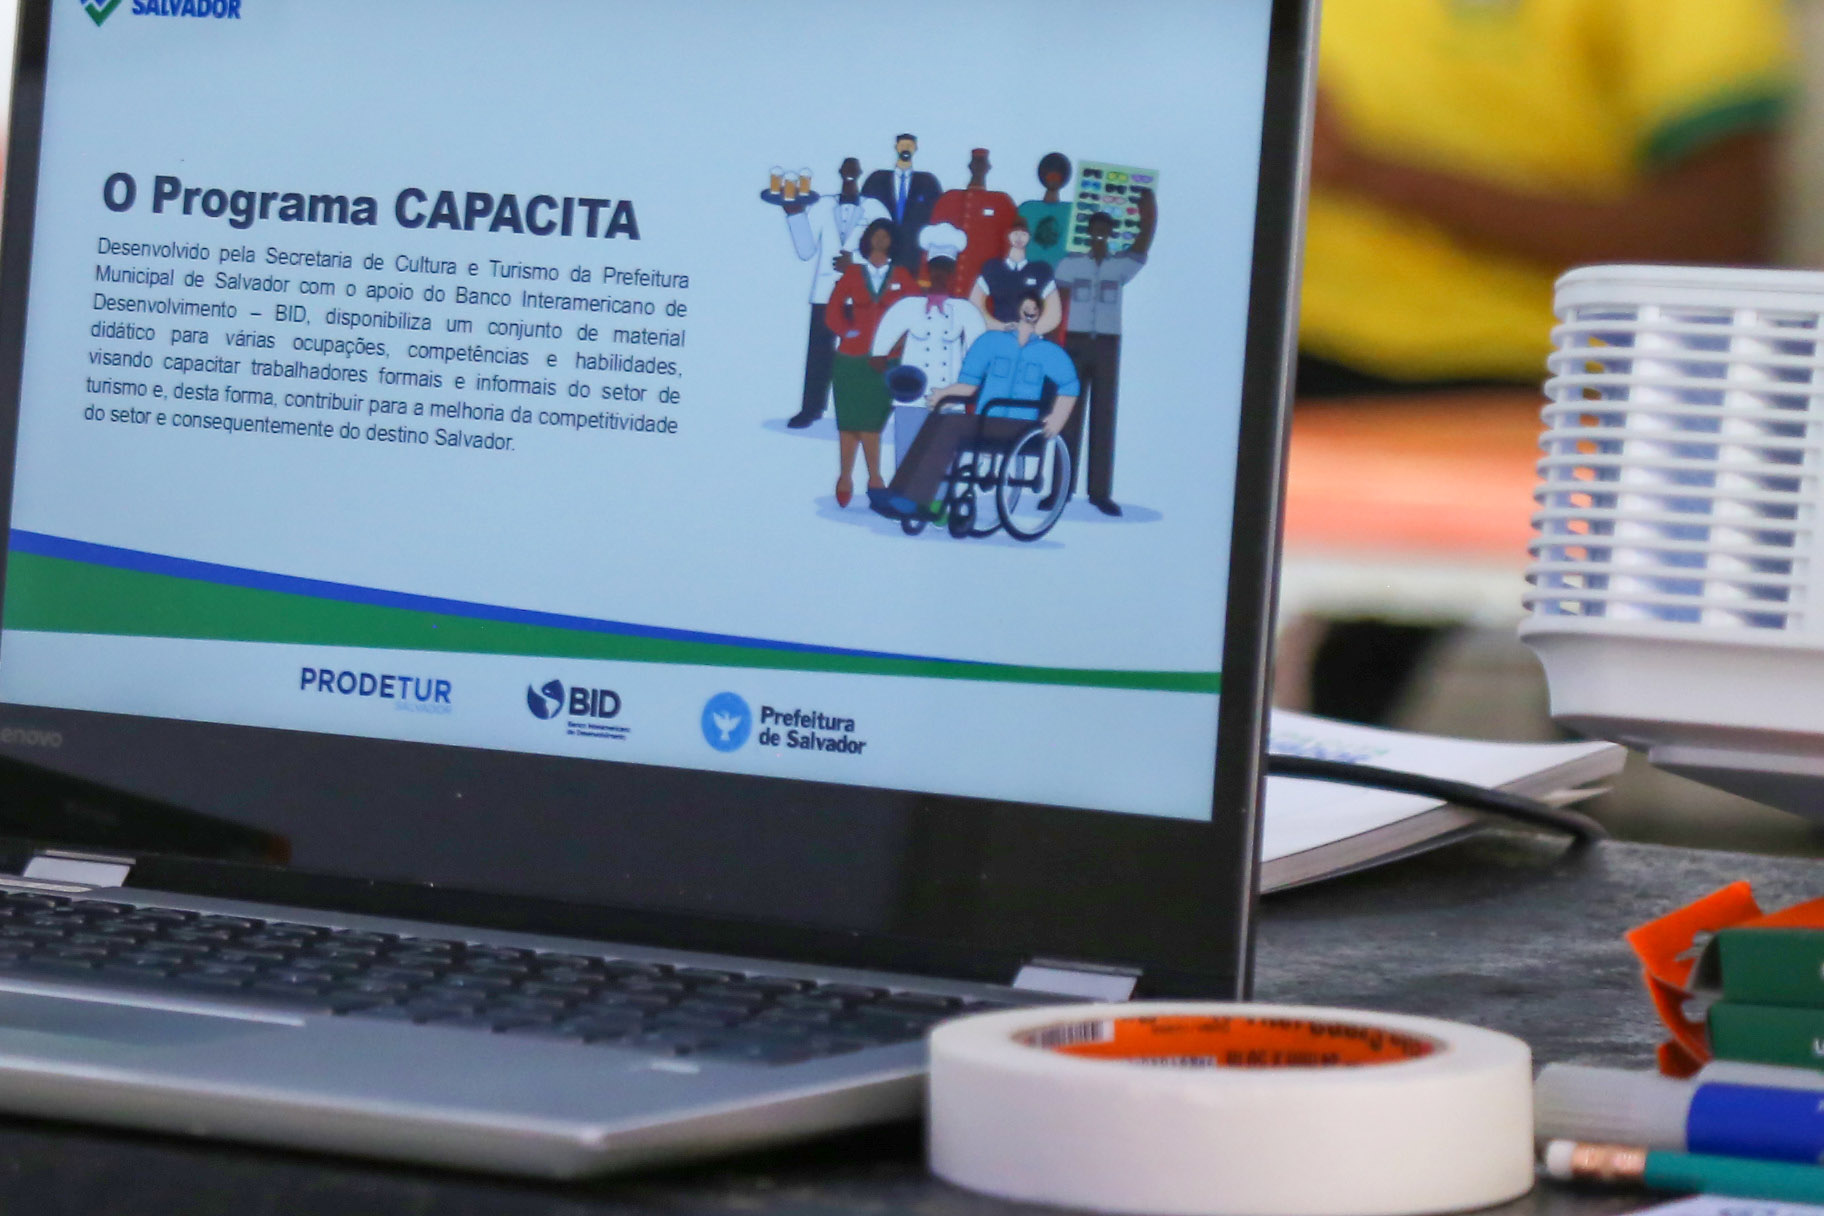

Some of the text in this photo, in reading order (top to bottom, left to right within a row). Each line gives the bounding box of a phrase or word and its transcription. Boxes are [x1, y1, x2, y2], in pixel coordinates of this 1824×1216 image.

[103, 172, 640, 240] O Programa CAPACITA
[97, 237, 690, 289] Desenvolvido pela Secretaria de Cultura e Turismo da Prefeitura
[95, 264, 688, 318] Municipal de Salvador com o apoio do Banco Interamericano de
[92, 292, 238, 319] Desenvolvimento
[274, 303, 311, 326] BID,
[325, 308, 432, 331] disponibiliza
[446, 319, 473, 334] um
[487, 320, 563, 341] conjunto
[576, 323, 599, 342] de
[613, 328, 686, 348] material
[90, 320, 682, 379] didático para várias ocupações, competências e habilidades,
[89, 348, 681, 405] visando capacitar trabalhadores formais e informais do setor de
[84, 404, 515, 451] do setor e consequentemente do destino Salvador.
[86, 376, 679, 434] turismo e, desta forma, contribuir para a melhoria da competitividade
[300, 667, 452, 704] PRODETUR
[568, 687, 621, 718] BID
[758, 729, 866, 756] de Salvador
[759, 706, 855, 732] Prefeitura
